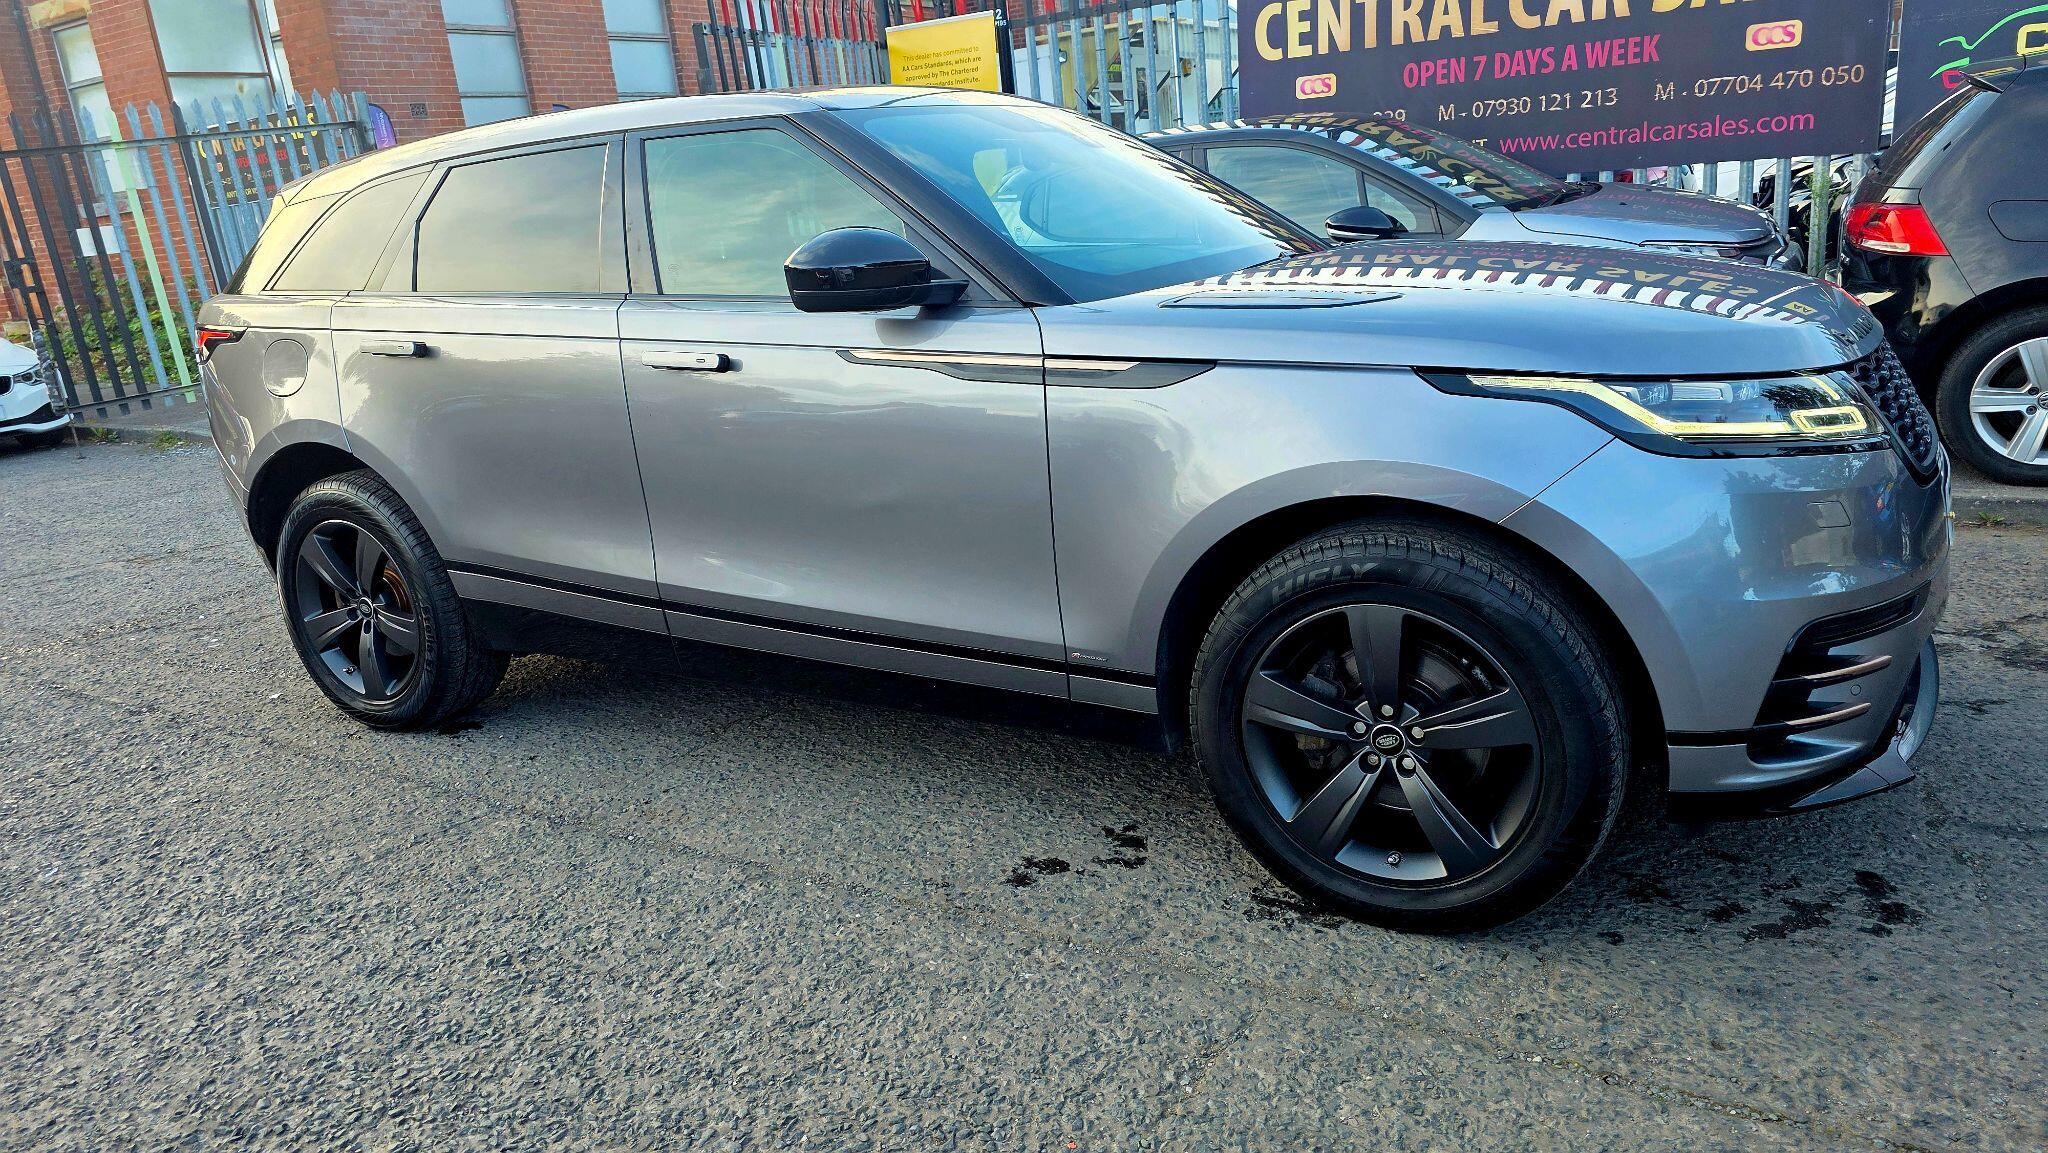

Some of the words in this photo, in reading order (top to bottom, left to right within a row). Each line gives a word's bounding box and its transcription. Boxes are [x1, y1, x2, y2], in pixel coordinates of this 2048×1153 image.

[1255, 0, 1499, 61] CENTRAL
[910, 63, 923, 71] Cars
[924, 60, 954, 70] Standards,
[954, 57, 972, 65] which
[915, 53, 931, 61] dealer
[932, 51, 942, 59] has
[943, 46, 972, 56] committed
[1403, 56, 1466, 88] OPEN
[1473, 55, 1487, 81] 7
[1494, 47, 1555, 79] DAYS
[1561, 44, 1578, 72] A
[1585, 34, 1661, 69] WEEK
[905, 72, 930, 83] approved
[950, 66, 979, 76] Chartered
[1654, 82, 1675, 100] M
[1694, 73, 1763, 97] 07704
[1769, 69, 1814, 90] 470
[1821, 64, 1865, 86] 050
[1438, 104, 1455, 121] M
[1472, 96, 1531, 118] 07930
[1539, 92, 1572, 112] 121
[1580, 87, 1618, 108] 213
[1500, 110, 1815, 154] www.centralcarsales.com
